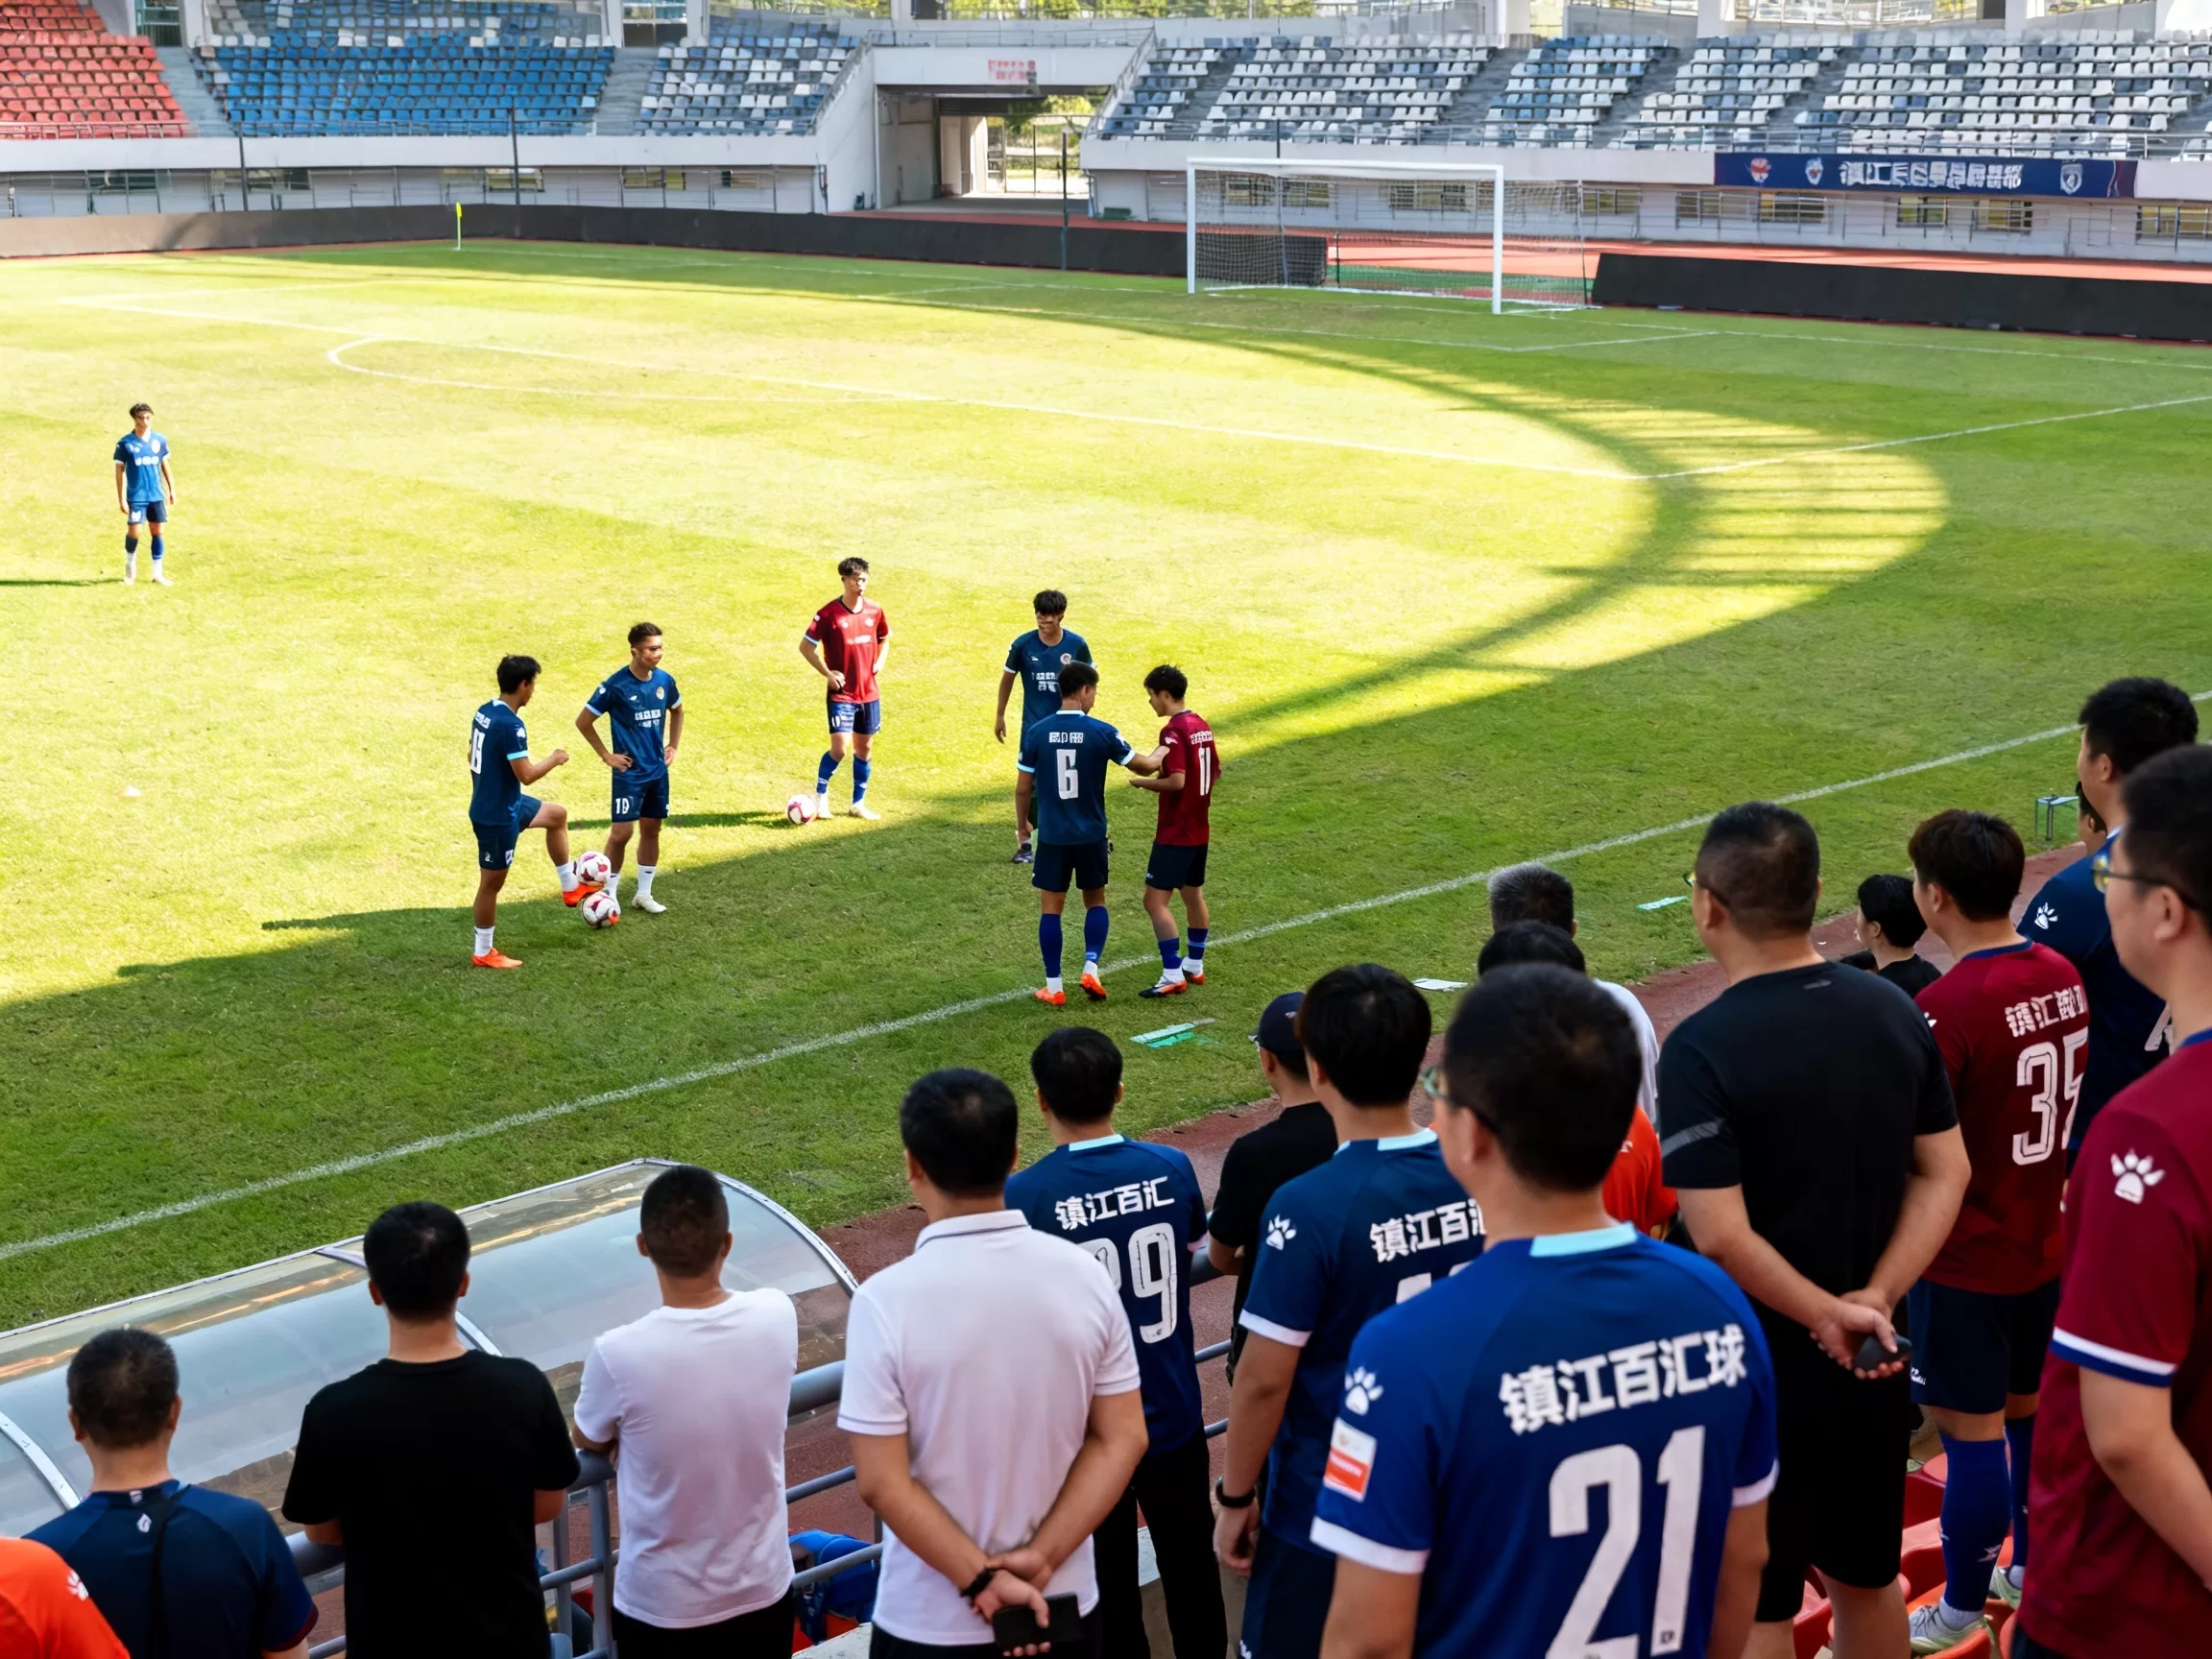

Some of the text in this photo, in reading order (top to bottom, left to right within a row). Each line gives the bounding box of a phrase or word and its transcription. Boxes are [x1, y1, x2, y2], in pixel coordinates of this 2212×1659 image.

[1056, 749, 1079, 800] 6
[1198, 746, 1212, 797] 11
[1055, 1175, 1175, 1230] 镇江百汇
[1499, 1323, 1747, 1436] 镇江百汇球
[1547, 1425, 1706, 1659] 21
